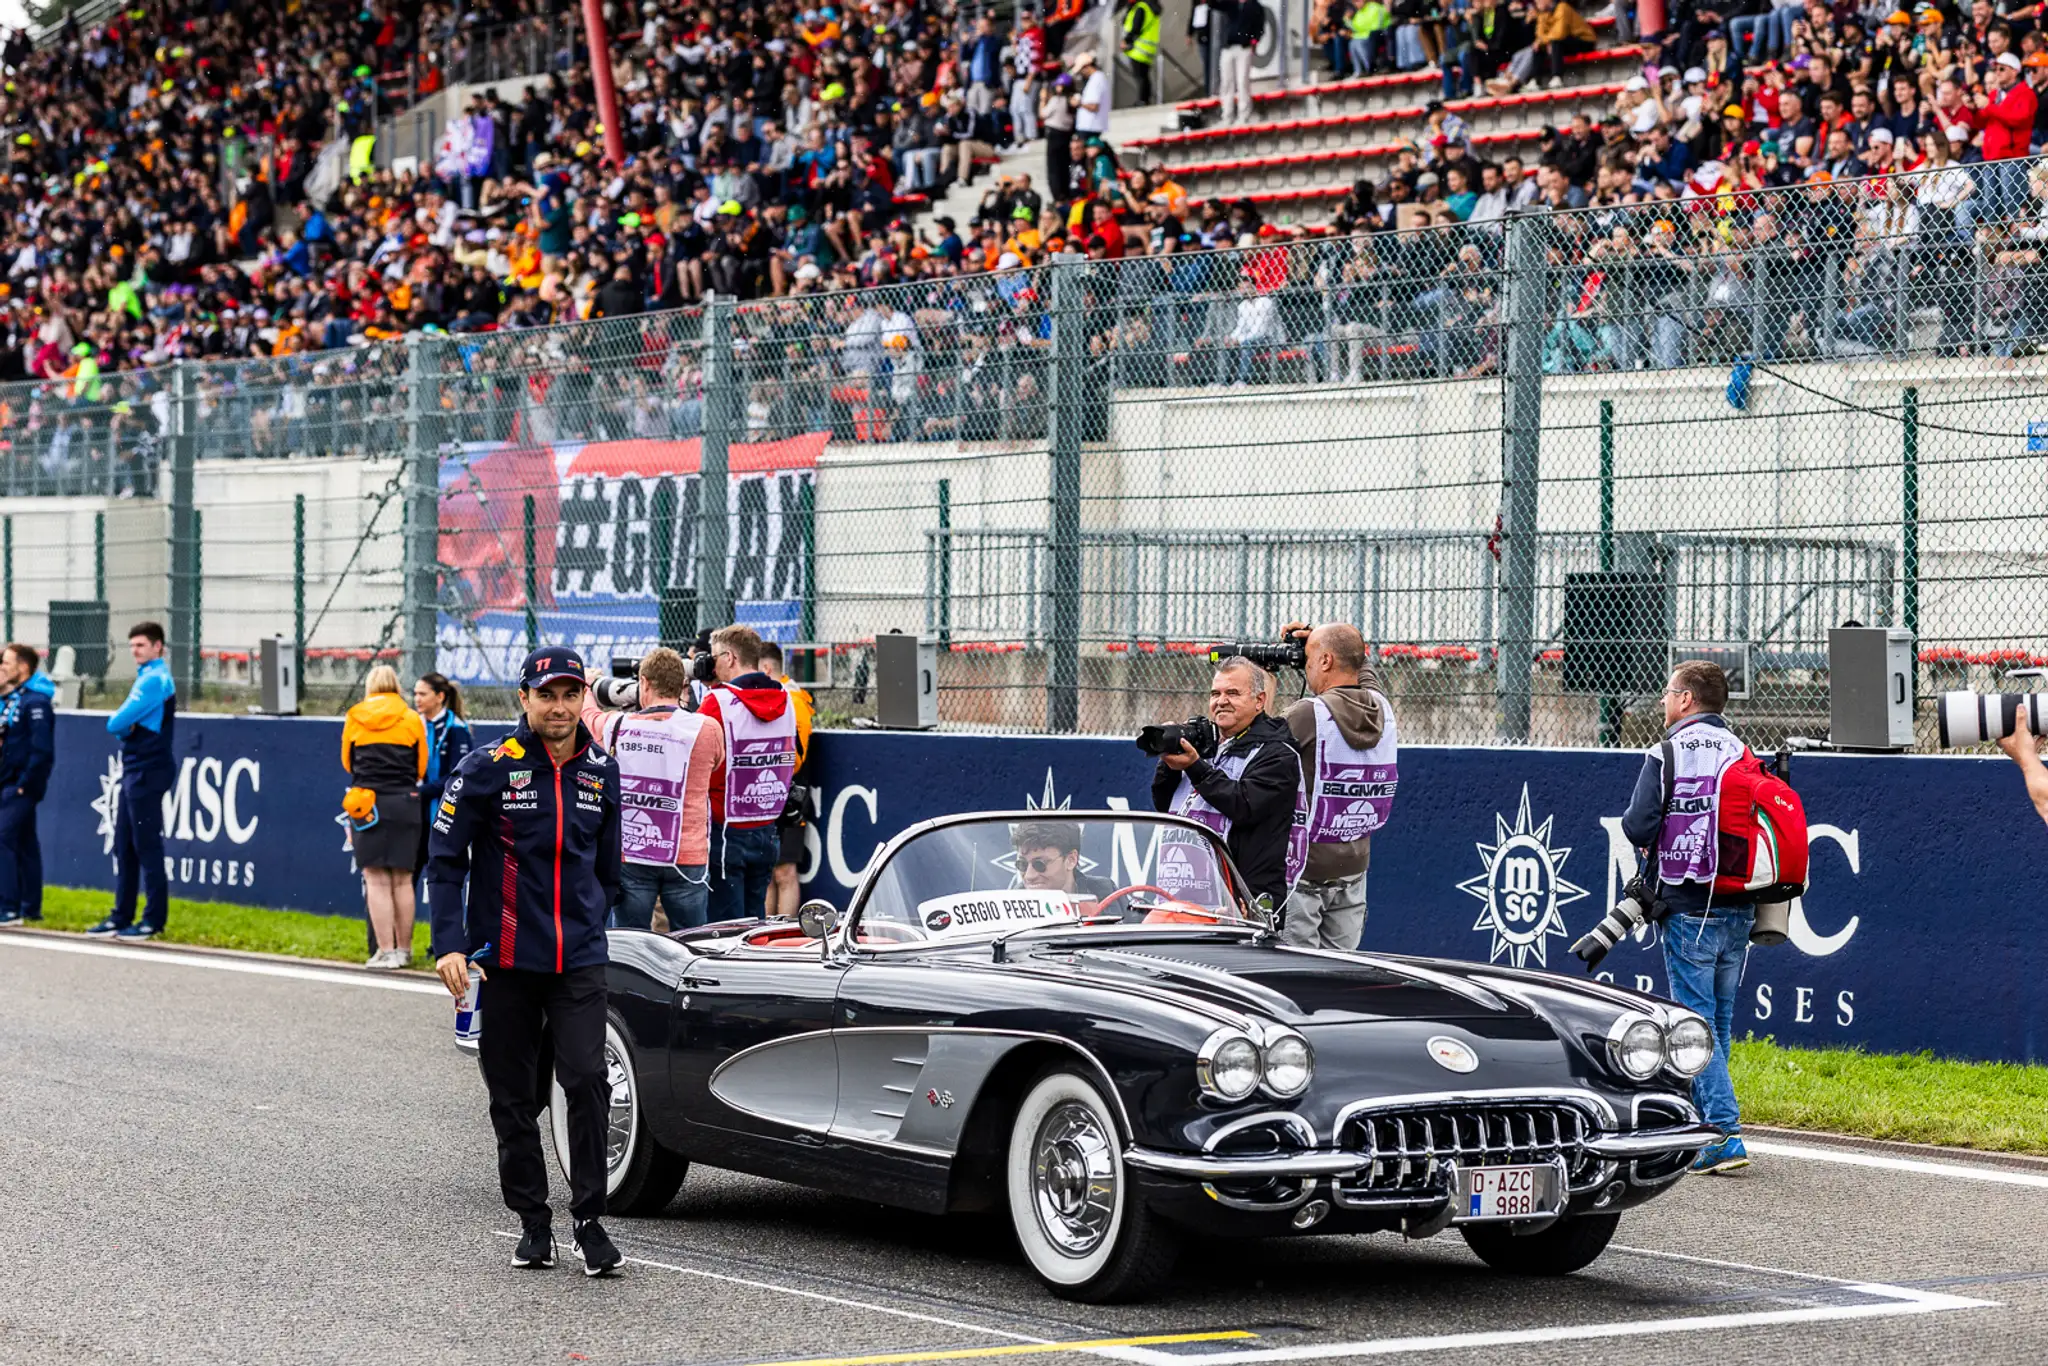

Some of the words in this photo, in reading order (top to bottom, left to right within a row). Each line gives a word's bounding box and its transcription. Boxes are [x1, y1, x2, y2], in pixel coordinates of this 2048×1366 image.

[535, 658, 552, 672] 11
[620, 742, 665, 754] 1385-BEL
[1330, 813, 1378, 828] MEDIA
[621, 823, 663, 839] EDIA
[164, 856, 255, 887] RUISES
[953, 901, 1001, 926] SERGIO
[1003, 899, 1045, 919] PEREZ
[1496, 1195, 1531, 1215] 988
